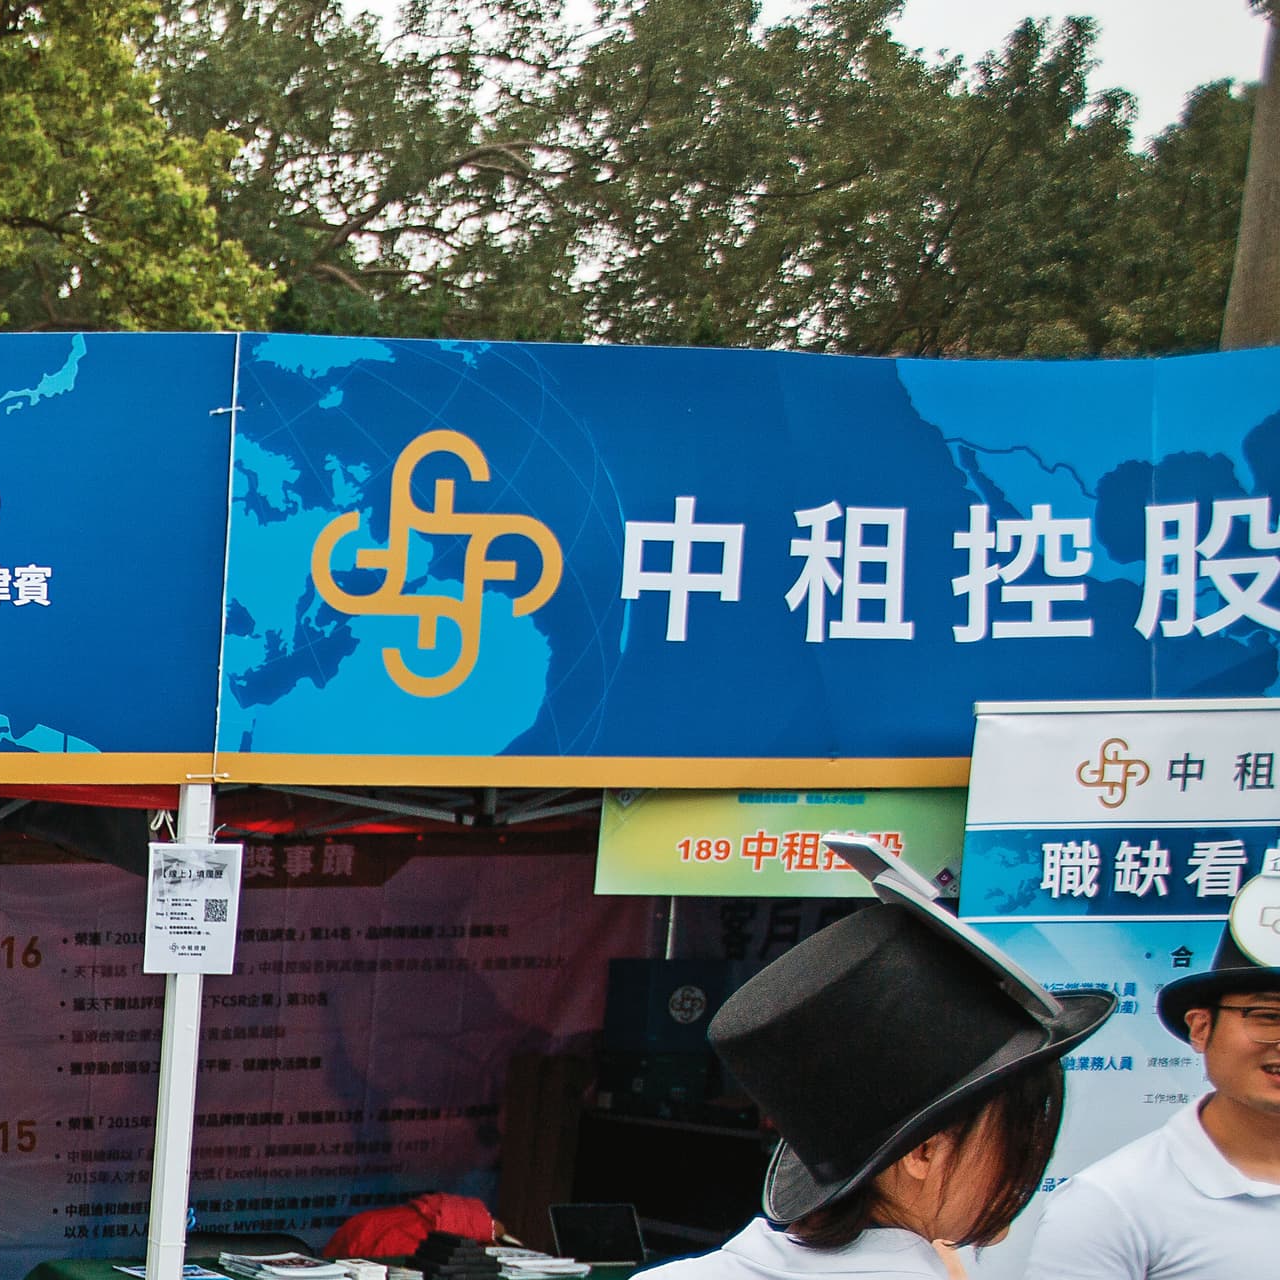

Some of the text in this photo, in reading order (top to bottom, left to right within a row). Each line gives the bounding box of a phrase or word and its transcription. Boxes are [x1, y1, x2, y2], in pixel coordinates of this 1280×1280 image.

[621, 496, 1280, 642] 中租控股
[1166, 751, 1275, 793] 中租
[676, 839, 731, 861] 189
[1040, 839, 1248, 899] 職缺看
